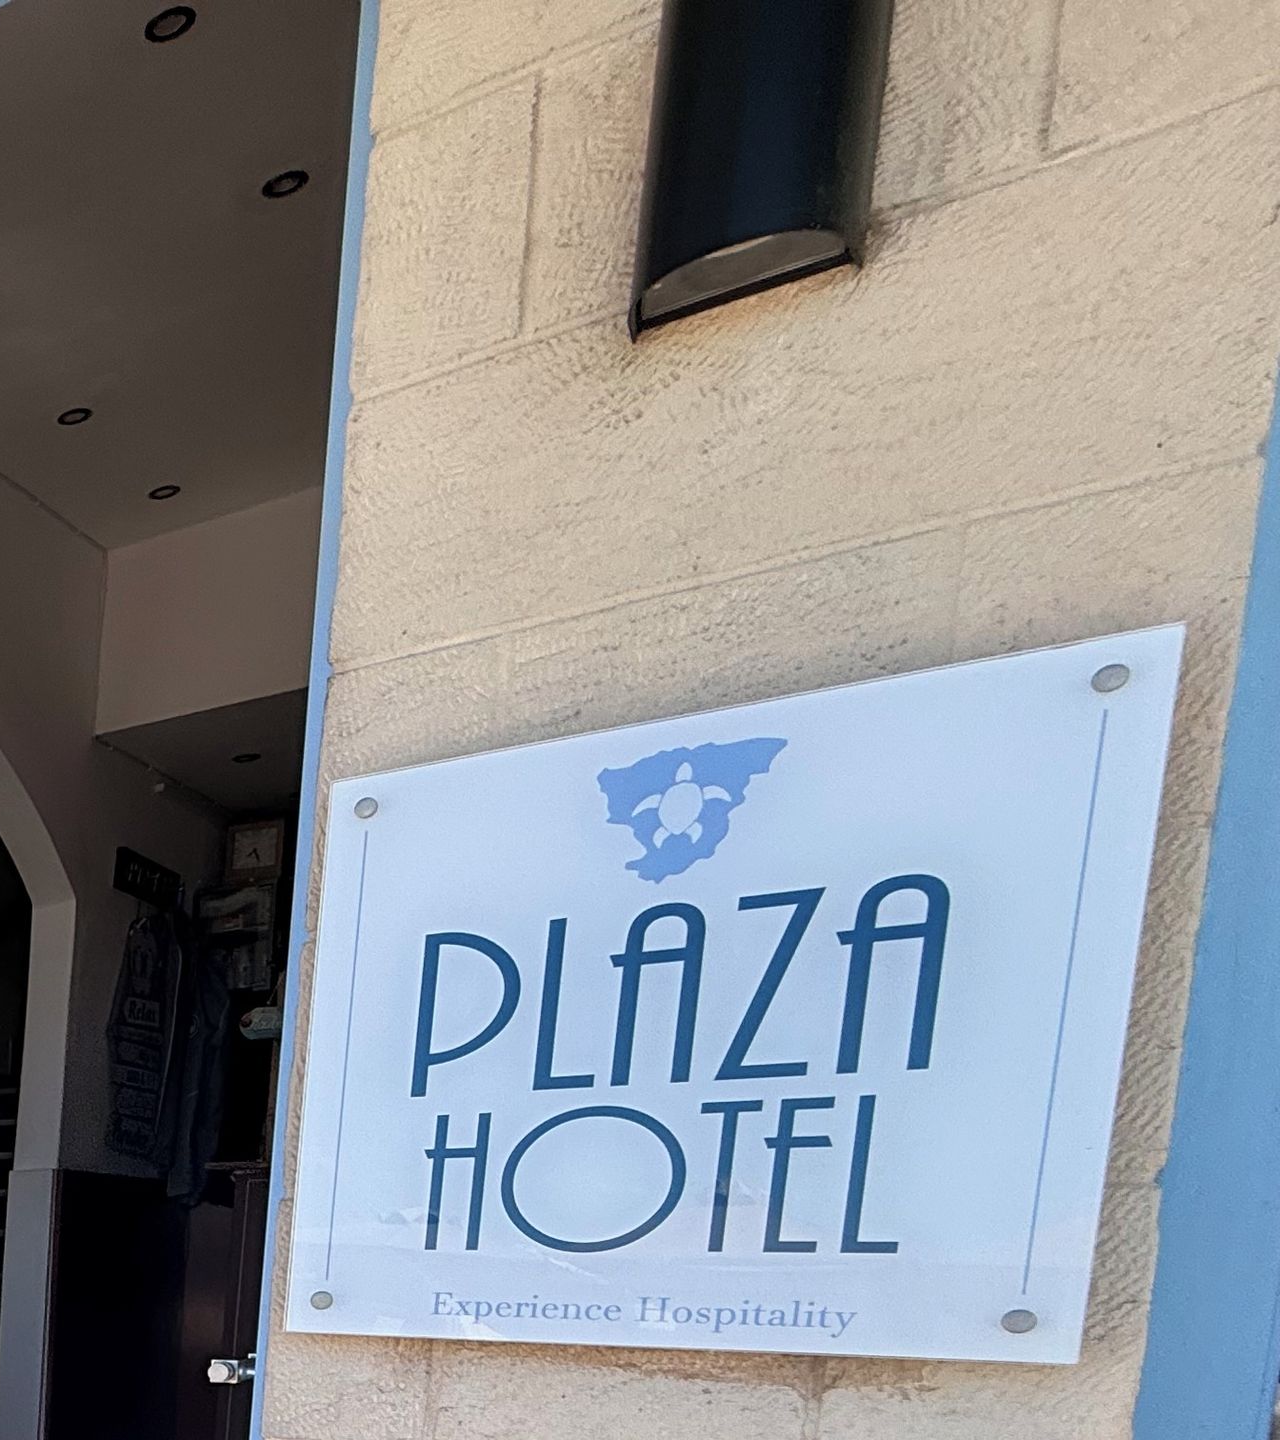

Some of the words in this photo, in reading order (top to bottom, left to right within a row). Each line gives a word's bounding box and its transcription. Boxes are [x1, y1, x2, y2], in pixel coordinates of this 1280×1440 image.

[410, 873, 952, 1098] PLAZA
[424, 1094, 900, 1254] HOTEL
[430, 1290, 623, 1324] Experience
[633, 1295, 859, 1336] Hospitality
